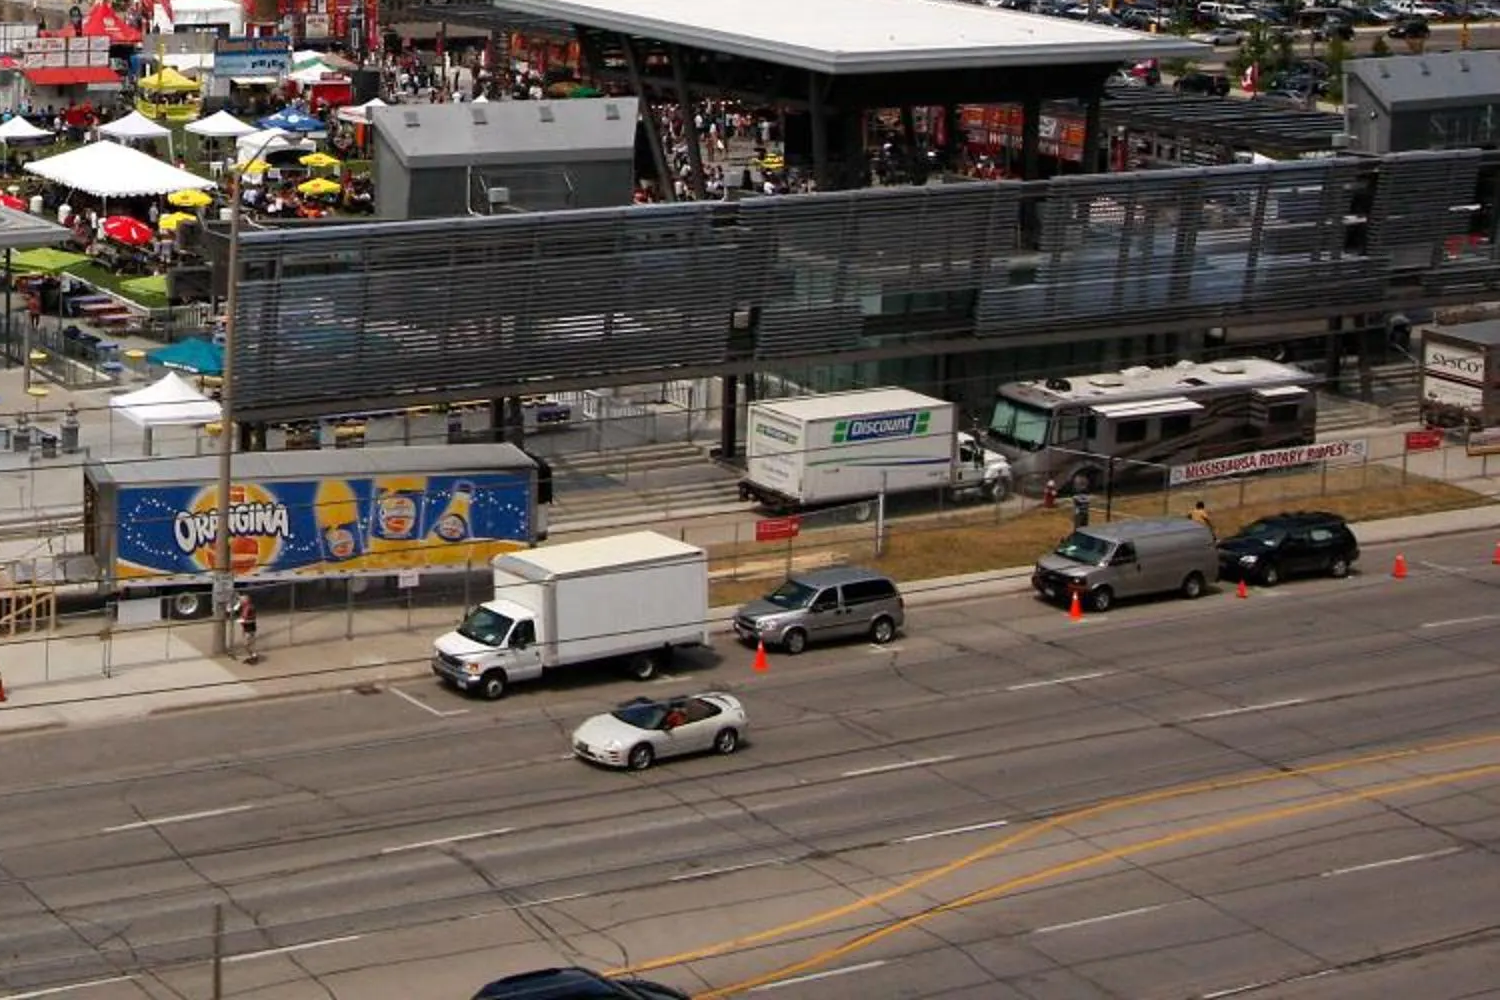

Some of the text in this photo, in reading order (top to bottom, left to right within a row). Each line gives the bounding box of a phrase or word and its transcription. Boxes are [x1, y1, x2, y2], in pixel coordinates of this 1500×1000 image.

[1185, 443, 1350, 479] MISSISSAUGA ROTARY RIBFEST
